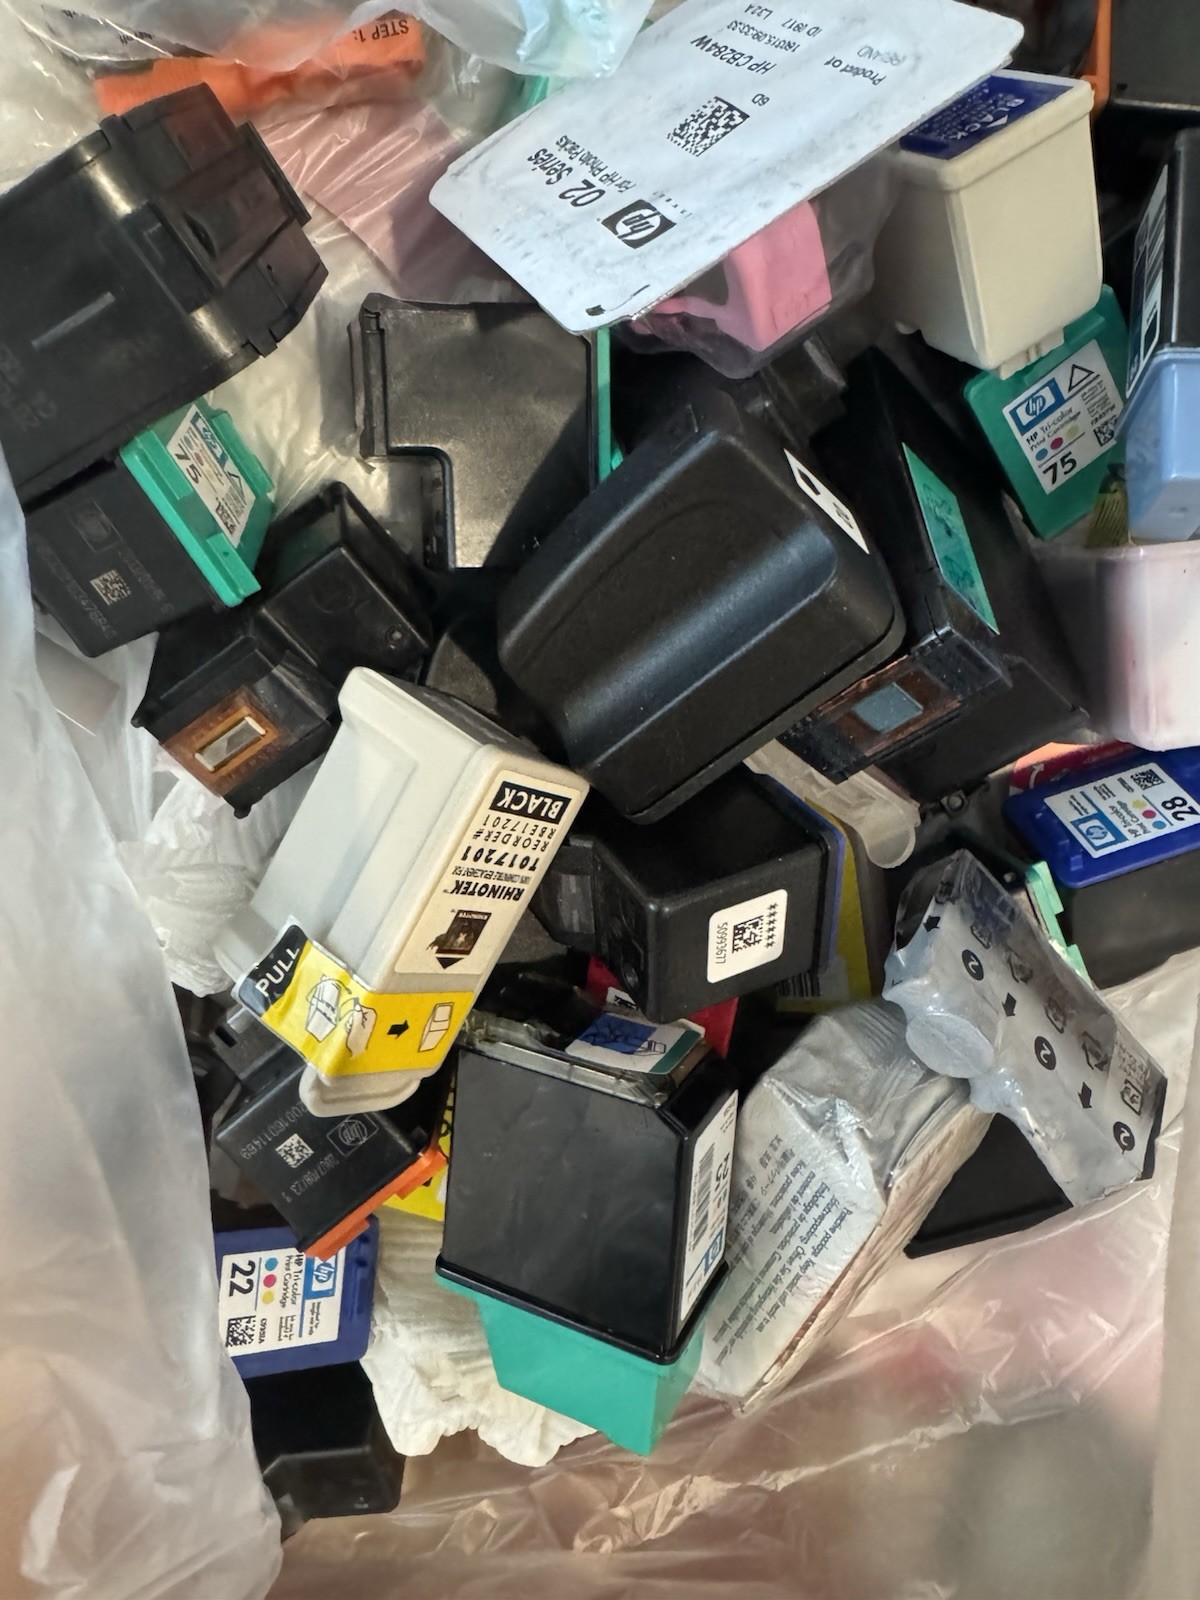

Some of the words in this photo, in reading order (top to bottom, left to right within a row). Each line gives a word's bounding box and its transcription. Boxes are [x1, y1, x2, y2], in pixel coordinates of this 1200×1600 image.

[370, 18, 409, 40] STEP
[689, 33, 753, 68] CB284W
[823, 55, 843, 66] of
[747, 58, 776, 74] HP
[839, 63, 885, 85] Product
[948, 98, 1025, 141] BLACK
[556, 135, 585, 158] Packs
[526, 147, 573, 186] Series
[579, 150, 607, 176] Photo
[598, 168, 621, 184] HP
[558, 178, 605, 209] 02
[615, 177, 635, 194] For
[1026, 431, 1038, 444] HP
[1040, 408, 1073, 432] Tri-color
[174, 443, 201, 485] 75
[1043, 451, 1077, 485] 75
[495, 786, 563, 818] BLACK
[1161, 796, 1199, 821] 28
[460, 844, 539, 871] T017201
[256, 947, 300, 998] PULL
[828, 1207, 853, 1234] Protective
[294, 1253, 303, 1266] HP
[797, 1258, 816, 1274] Keep
[228, 1259, 255, 1297] 22
[279, 1272, 290, 1307] Cartridge
